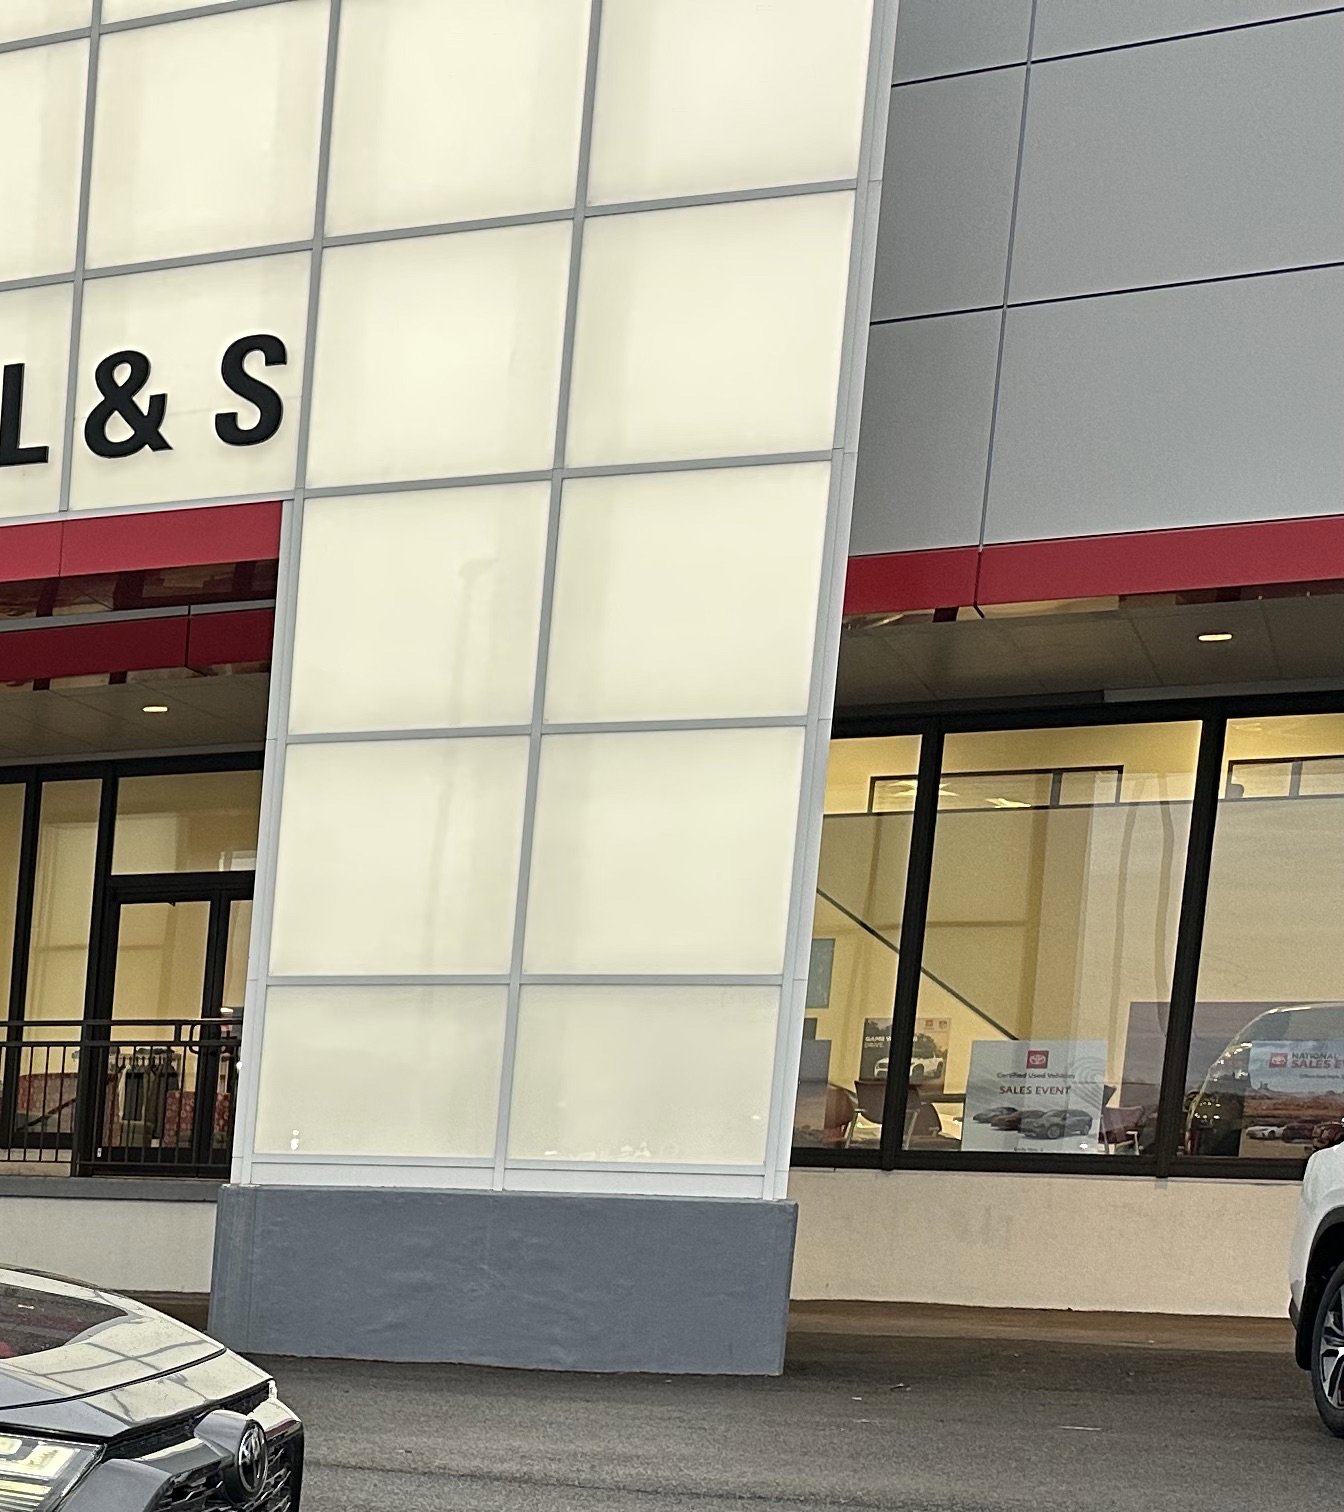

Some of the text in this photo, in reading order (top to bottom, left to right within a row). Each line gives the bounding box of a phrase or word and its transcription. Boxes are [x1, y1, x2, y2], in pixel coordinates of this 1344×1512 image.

[84, 350, 173, 459] &
[215, 334, 287, 446] S
[1291, 1060, 1331, 1069] SALES
[999, 1085, 1071, 1095] SALES EVENT
